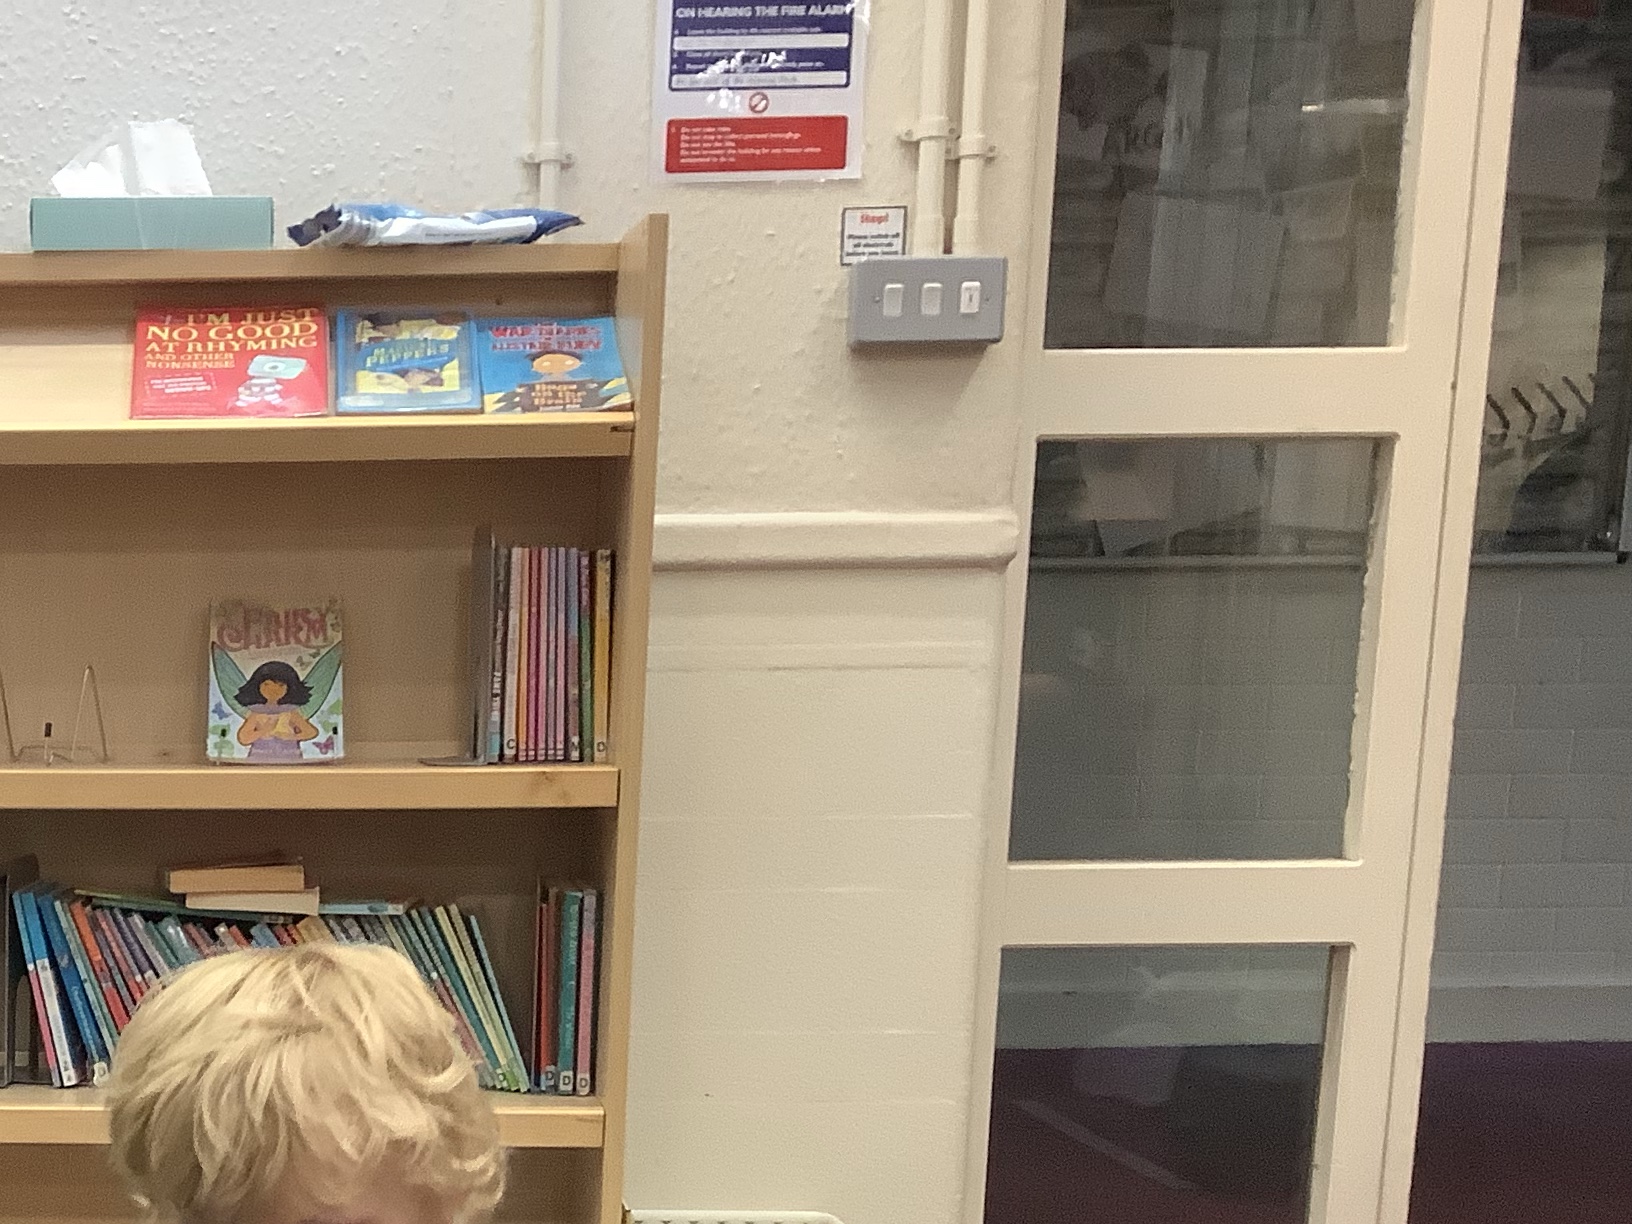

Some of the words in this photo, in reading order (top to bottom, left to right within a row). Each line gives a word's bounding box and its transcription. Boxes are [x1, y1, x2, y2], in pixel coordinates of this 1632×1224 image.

[675, 7, 695, 18] ON
[698, 6, 751, 17] HEARING
[755, 6, 779, 17] THE
[781, 5, 806, 16] FIRE
[188, 313, 230, 326] I'M
[240, 308, 317, 325] JUST
[146, 325, 198, 342] NO
[209, 322, 318, 340] GOOD
[145, 341, 179, 352] AT
[187, 336, 317, 352] RHYMING
[144, 353, 176, 361] AND
[180, 352, 234, 361] OTHER
[145, 360, 236, 369] NONSENSE
[506, 739, 516, 750] C
[562, 1076, 571, 1086] D
